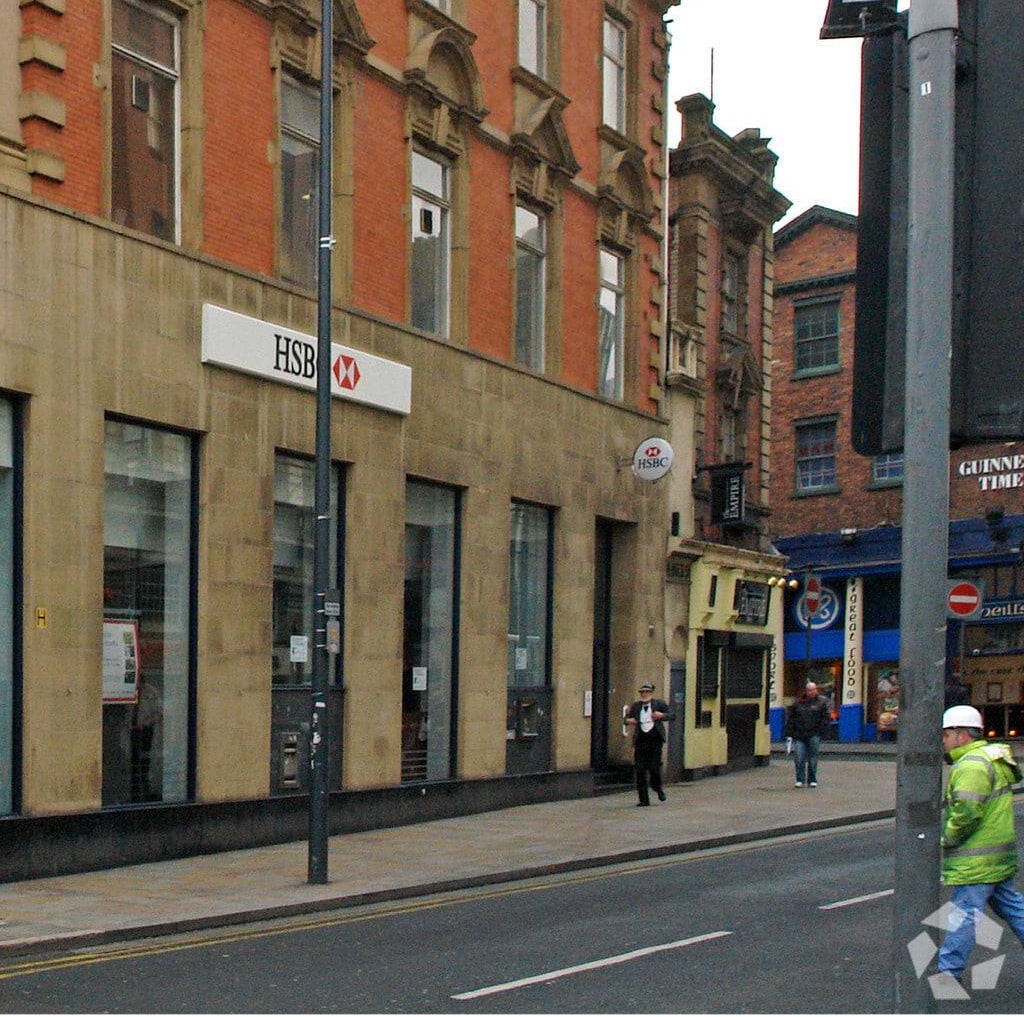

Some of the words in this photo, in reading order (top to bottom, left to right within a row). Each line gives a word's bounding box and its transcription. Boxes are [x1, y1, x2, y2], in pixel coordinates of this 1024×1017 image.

[273, 334, 318, 379] HSB
[638, 457, 668, 469] HSBC
[978, 473, 1024, 491] TIME
[730, 477, 740, 519] EMPIRE
[38, 609, 46, 626] H
